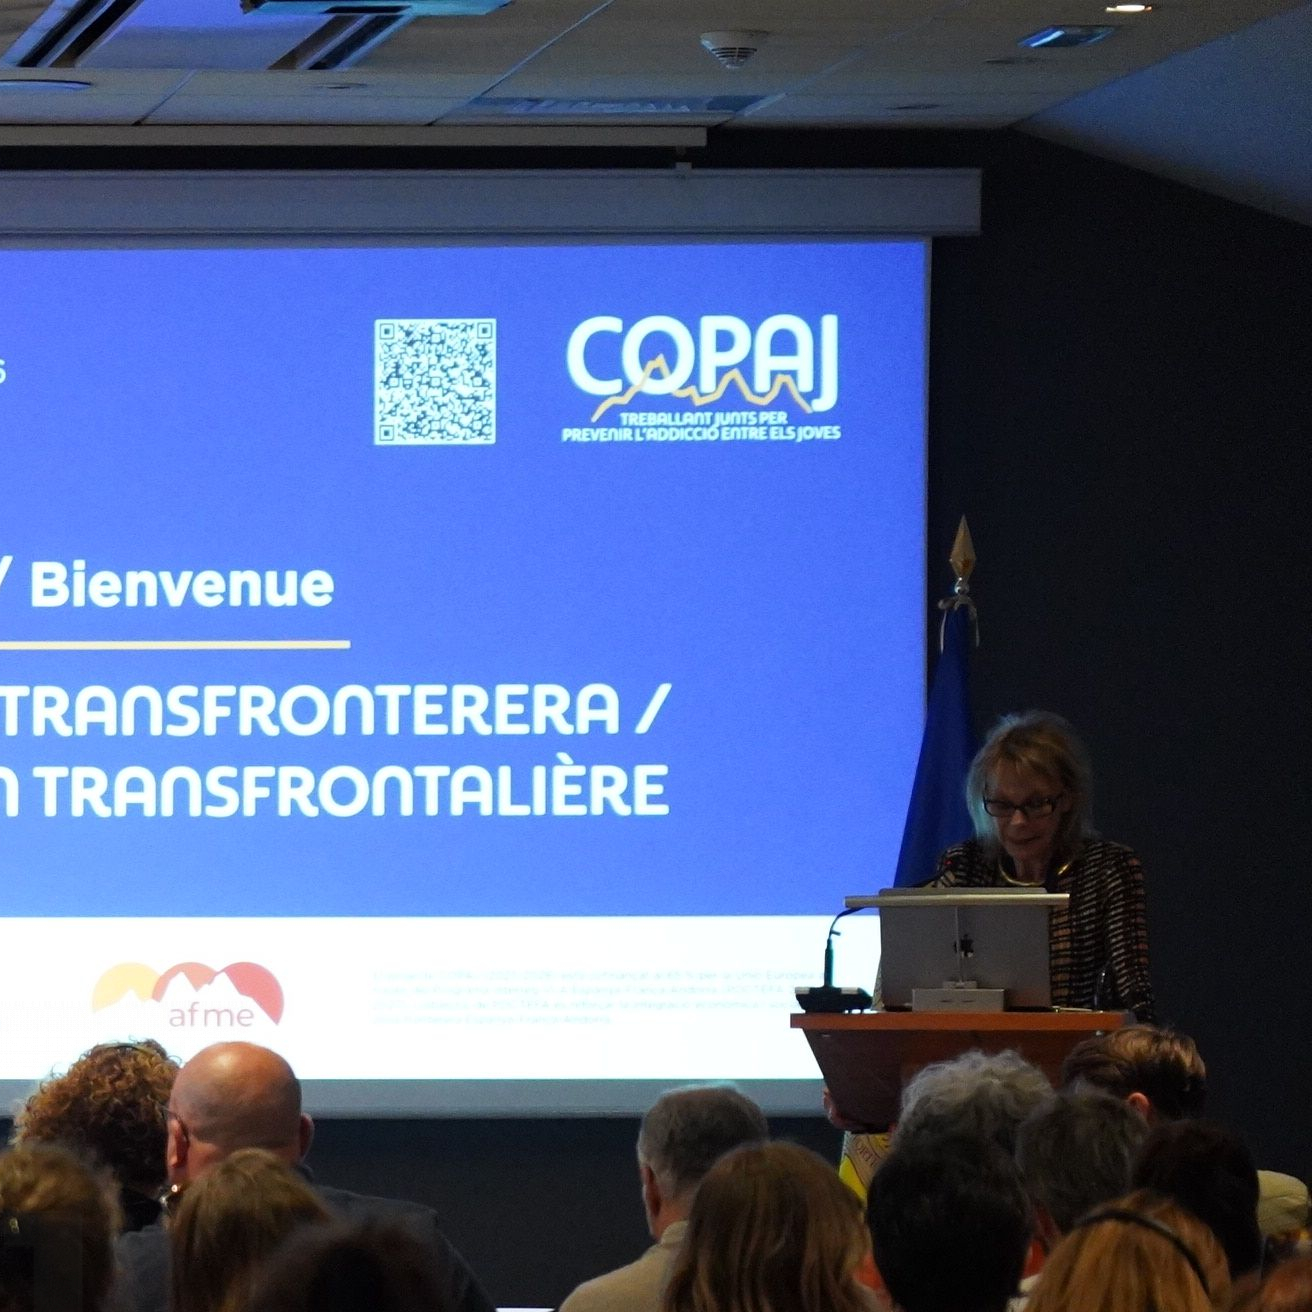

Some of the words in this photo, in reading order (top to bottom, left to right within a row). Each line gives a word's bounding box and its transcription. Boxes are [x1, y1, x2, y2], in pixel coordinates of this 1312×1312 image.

[567, 315, 839, 411] COPAJ
[562, 428, 633, 441] PREVENIR
[721, 427, 767, 440] ENTRE
[769, 427, 795, 440] ELS
[797, 426, 841, 442] JOVES
[620, 412, 712, 426] TREBALLANT
[715, 412, 757, 428] JUNTS
[761, 412, 788, 426] PER
[31, 559, 335, 608] Bienvenue
[32, 751, 670, 818] TRANSFRONTALIÈRE
[169, 1001, 254, 1027] afme
